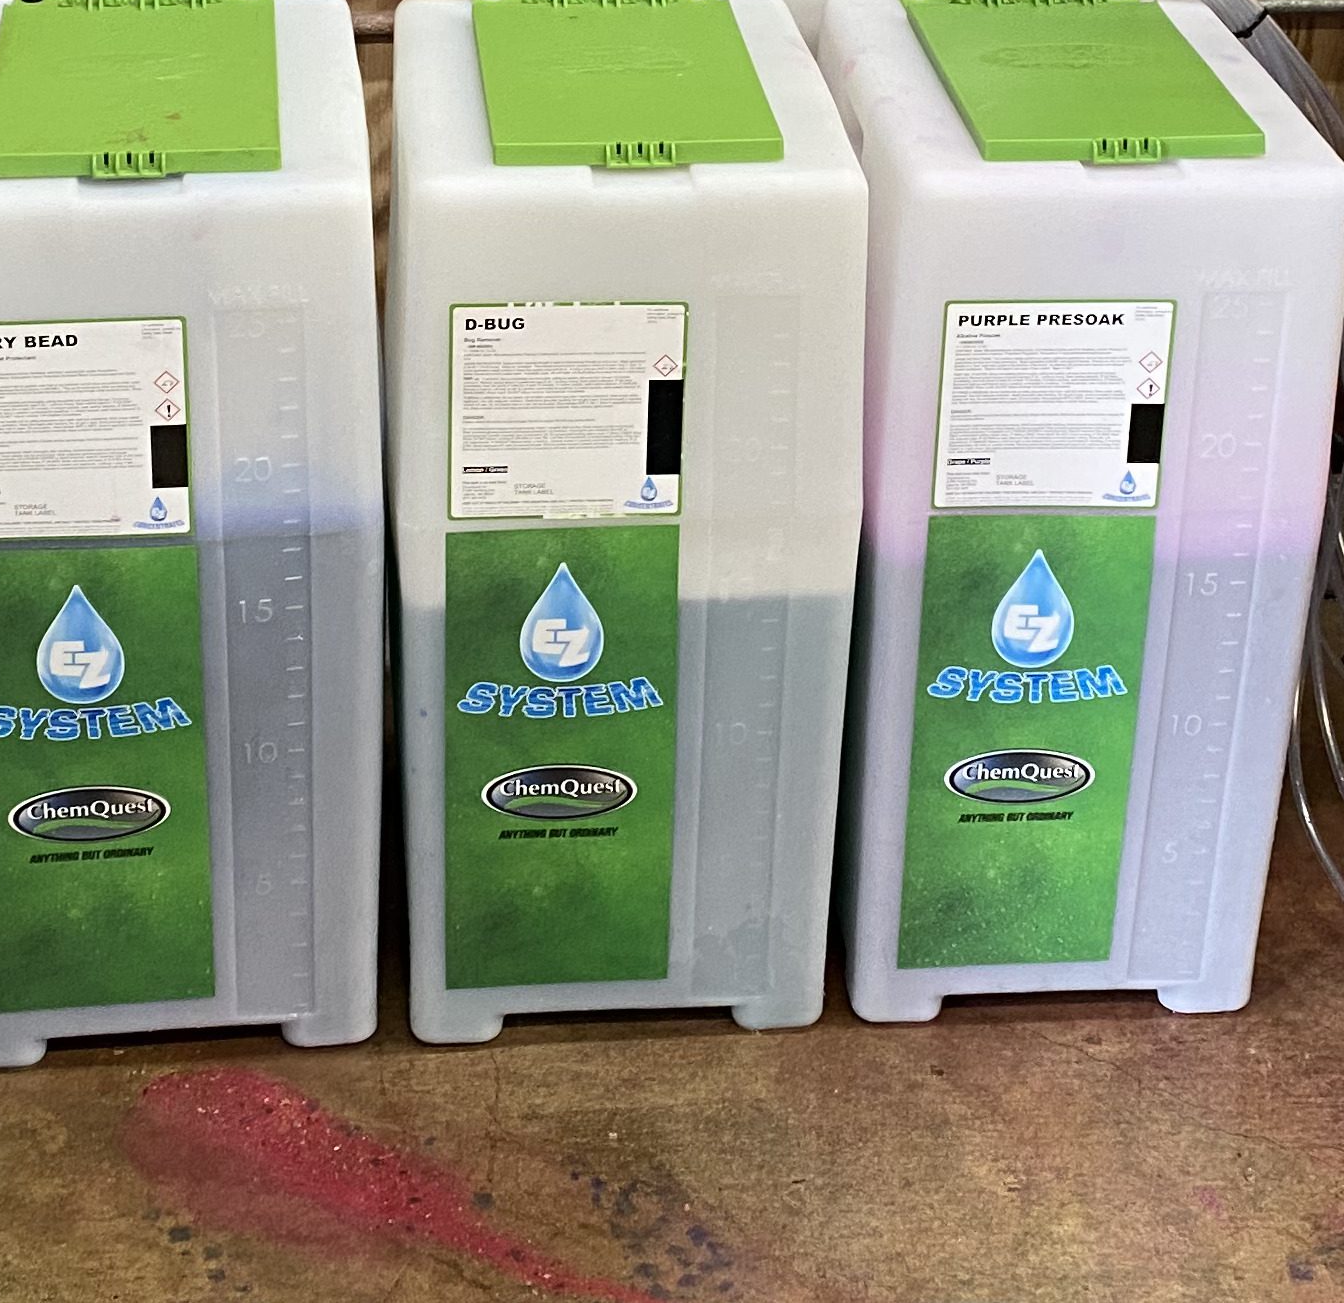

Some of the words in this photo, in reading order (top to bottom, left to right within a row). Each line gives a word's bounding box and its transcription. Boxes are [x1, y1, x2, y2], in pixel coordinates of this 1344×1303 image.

[465, 318, 525, 331] D-BUG
[958, 314, 1030, 326] PURPLE
[1037, 314, 1125, 326] PRESOAK
[24, 334, 78, 349] BEAD
[1202, 434, 1237, 459] 20
[234, 456, 273, 482] 20
[1186, 572, 1218, 596] 15
[237, 598, 274, 624] 15
[1004, 604, 1060, 654] EZ
[532, 618, 590, 668] EZ
[50, 640, 111, 689] EZ
[926, 664, 1129, 705] SYSTEM
[457, 676, 664, 719] SYSTEM
[1171, 714, 1202, 738] 10
[243, 740, 278, 766] 10
[962, 762, 1082, 782] ChemQuest
[499, 778, 624, 800] ChemQuest
[26, 797, 158, 821] ChemQuest
[29, 850, 80, 864] ANYTHING
[81, 850, 102, 862] BUT
